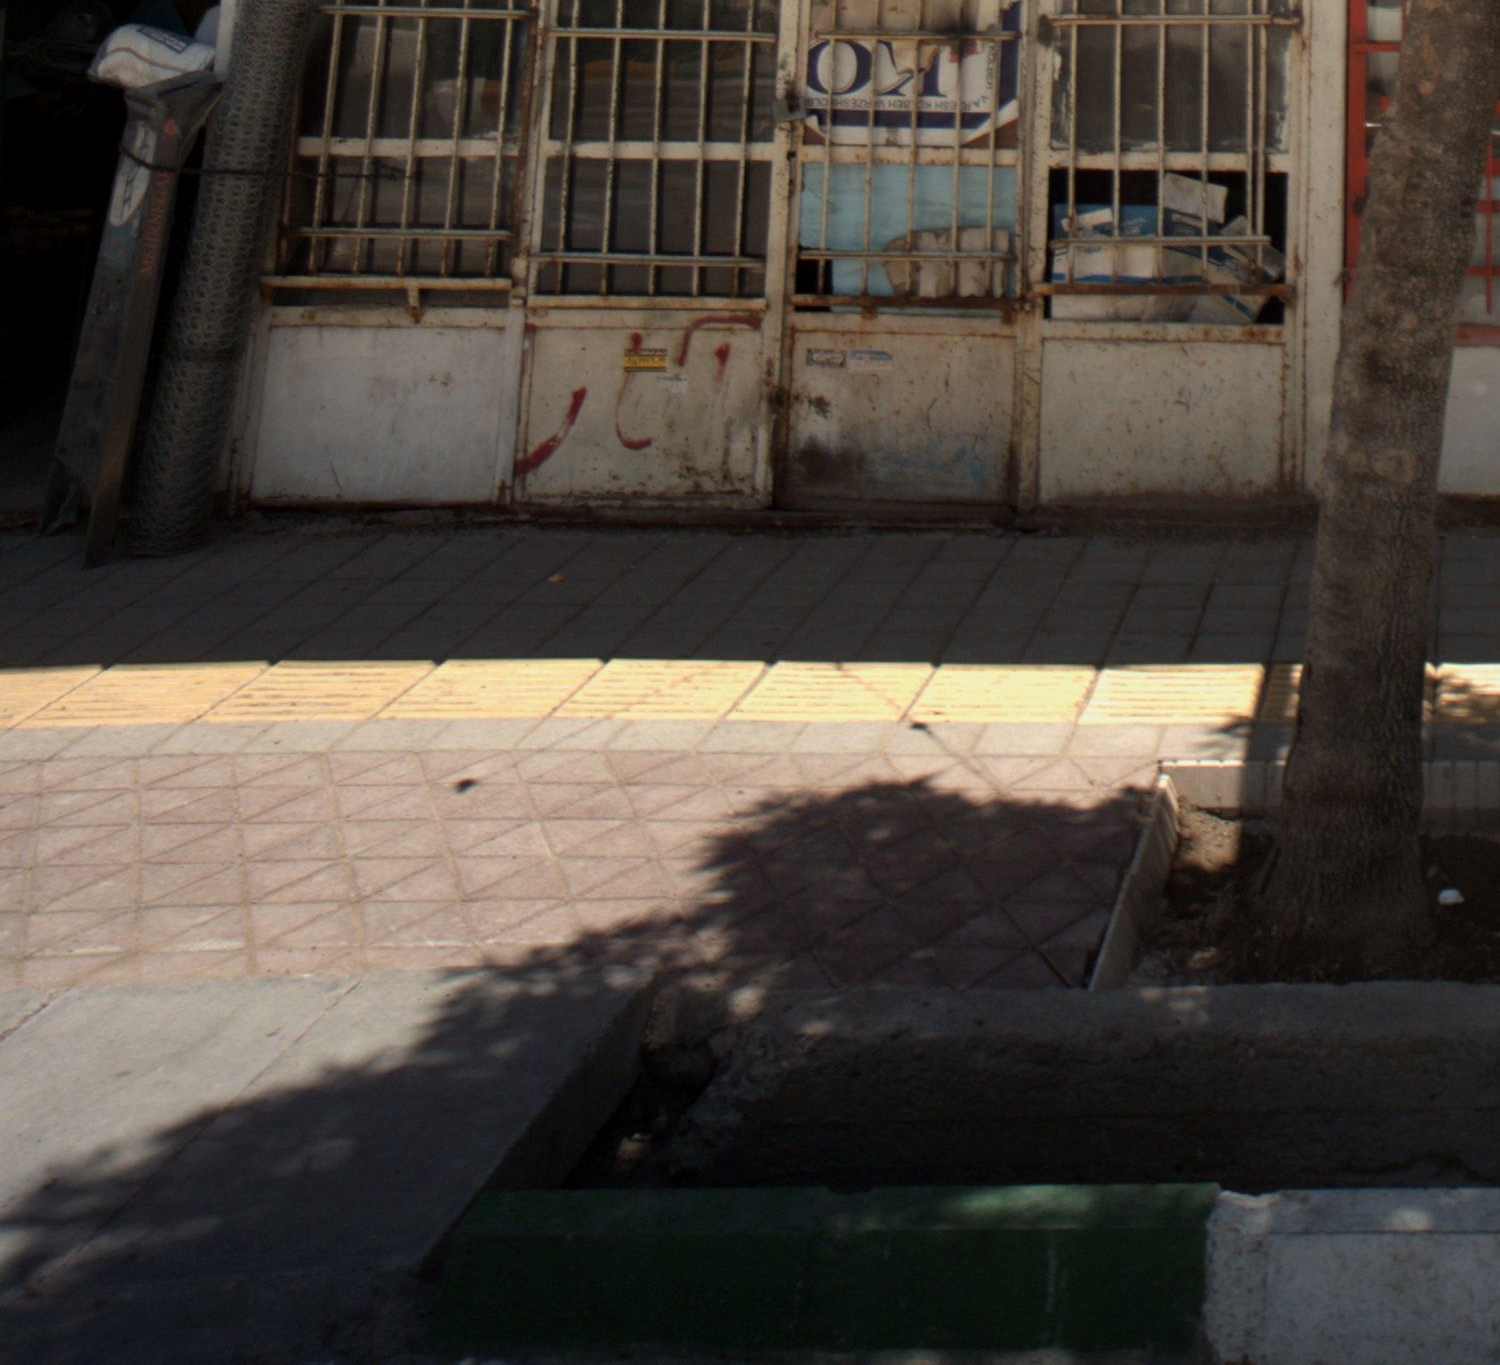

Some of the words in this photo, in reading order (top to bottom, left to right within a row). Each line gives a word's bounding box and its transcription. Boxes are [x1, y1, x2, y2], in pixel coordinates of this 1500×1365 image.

[836, 98, 885, 109] VRZESH
[888, 99, 932, 110] KOBEH
[934, 95, 989, 111] VARESH
